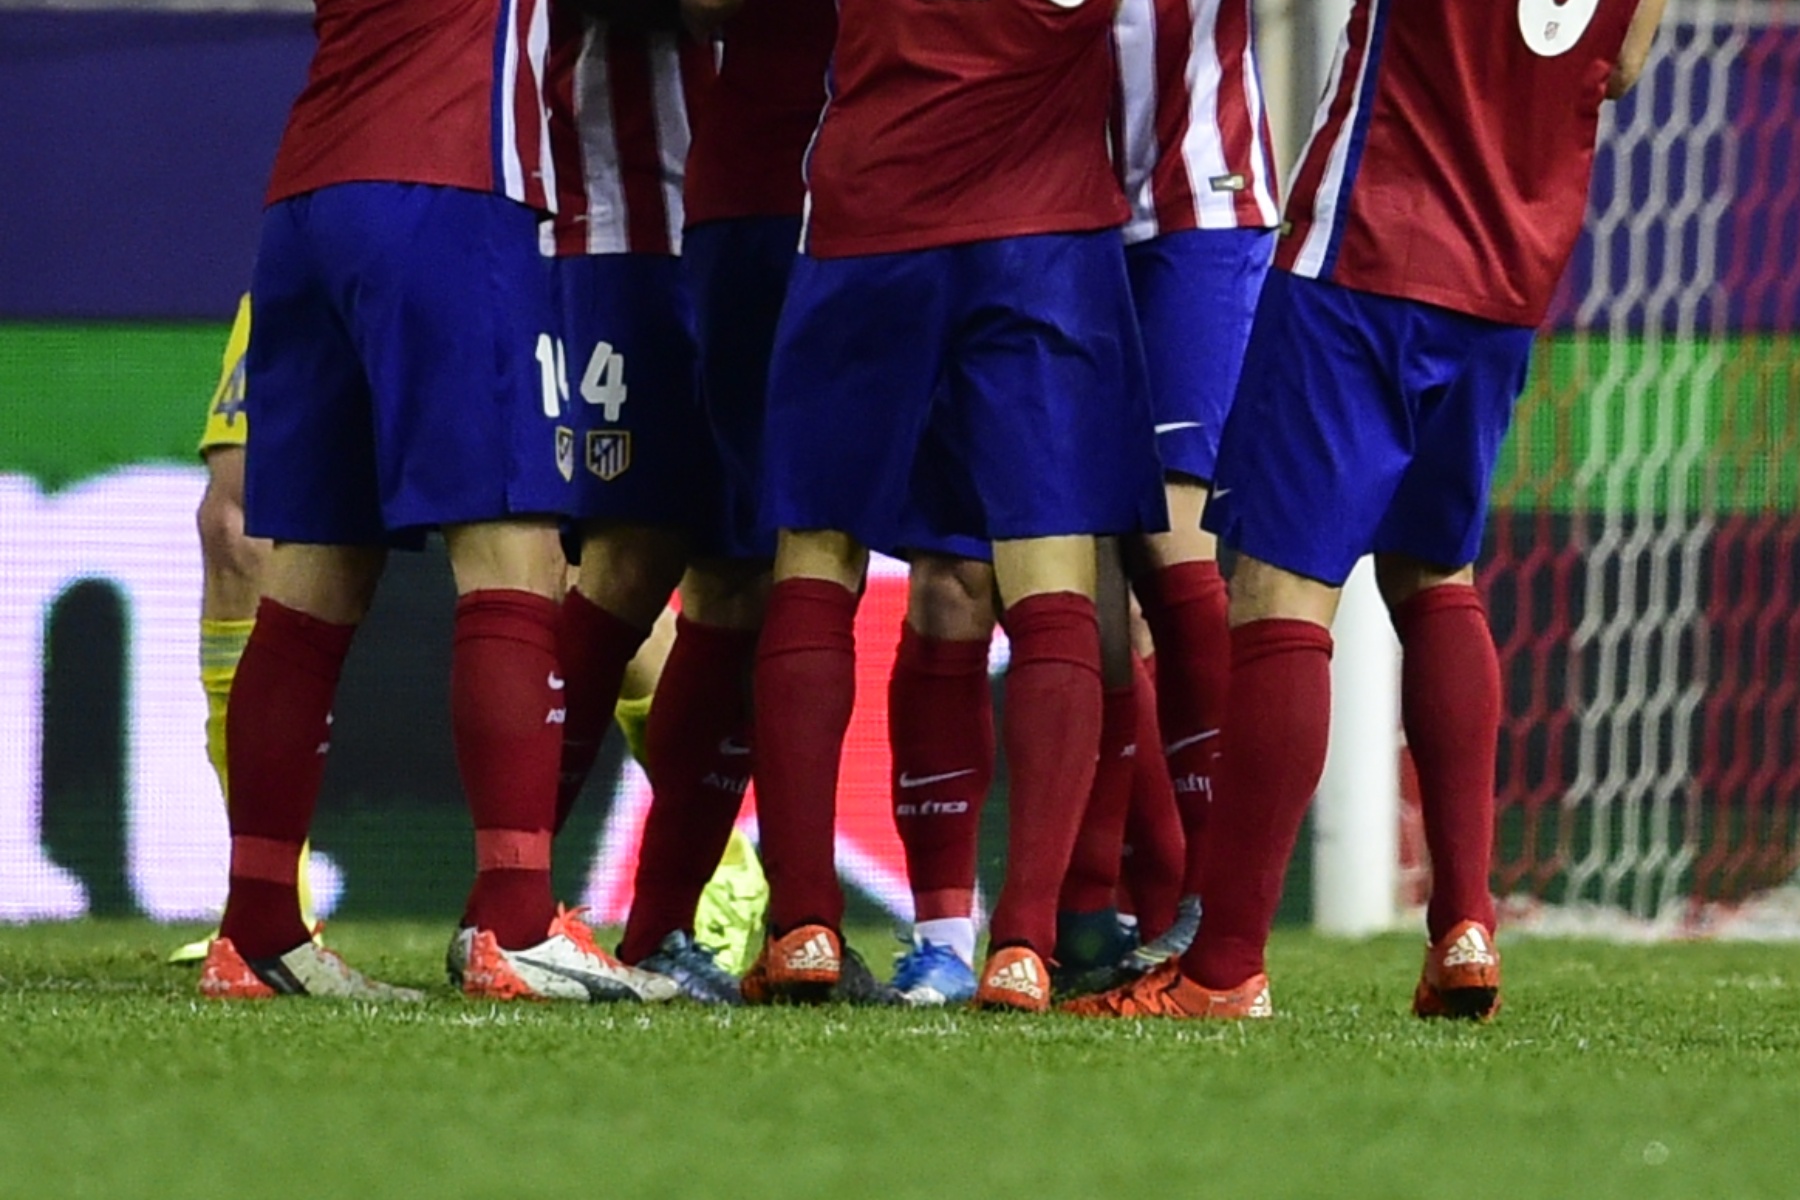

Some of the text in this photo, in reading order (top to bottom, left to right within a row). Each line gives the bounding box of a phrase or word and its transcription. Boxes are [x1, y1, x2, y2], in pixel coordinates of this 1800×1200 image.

[580, 341, 627, 421] 4
[785, 956, 841, 972] adidas
[988, 975, 1043, 1000] adidas
